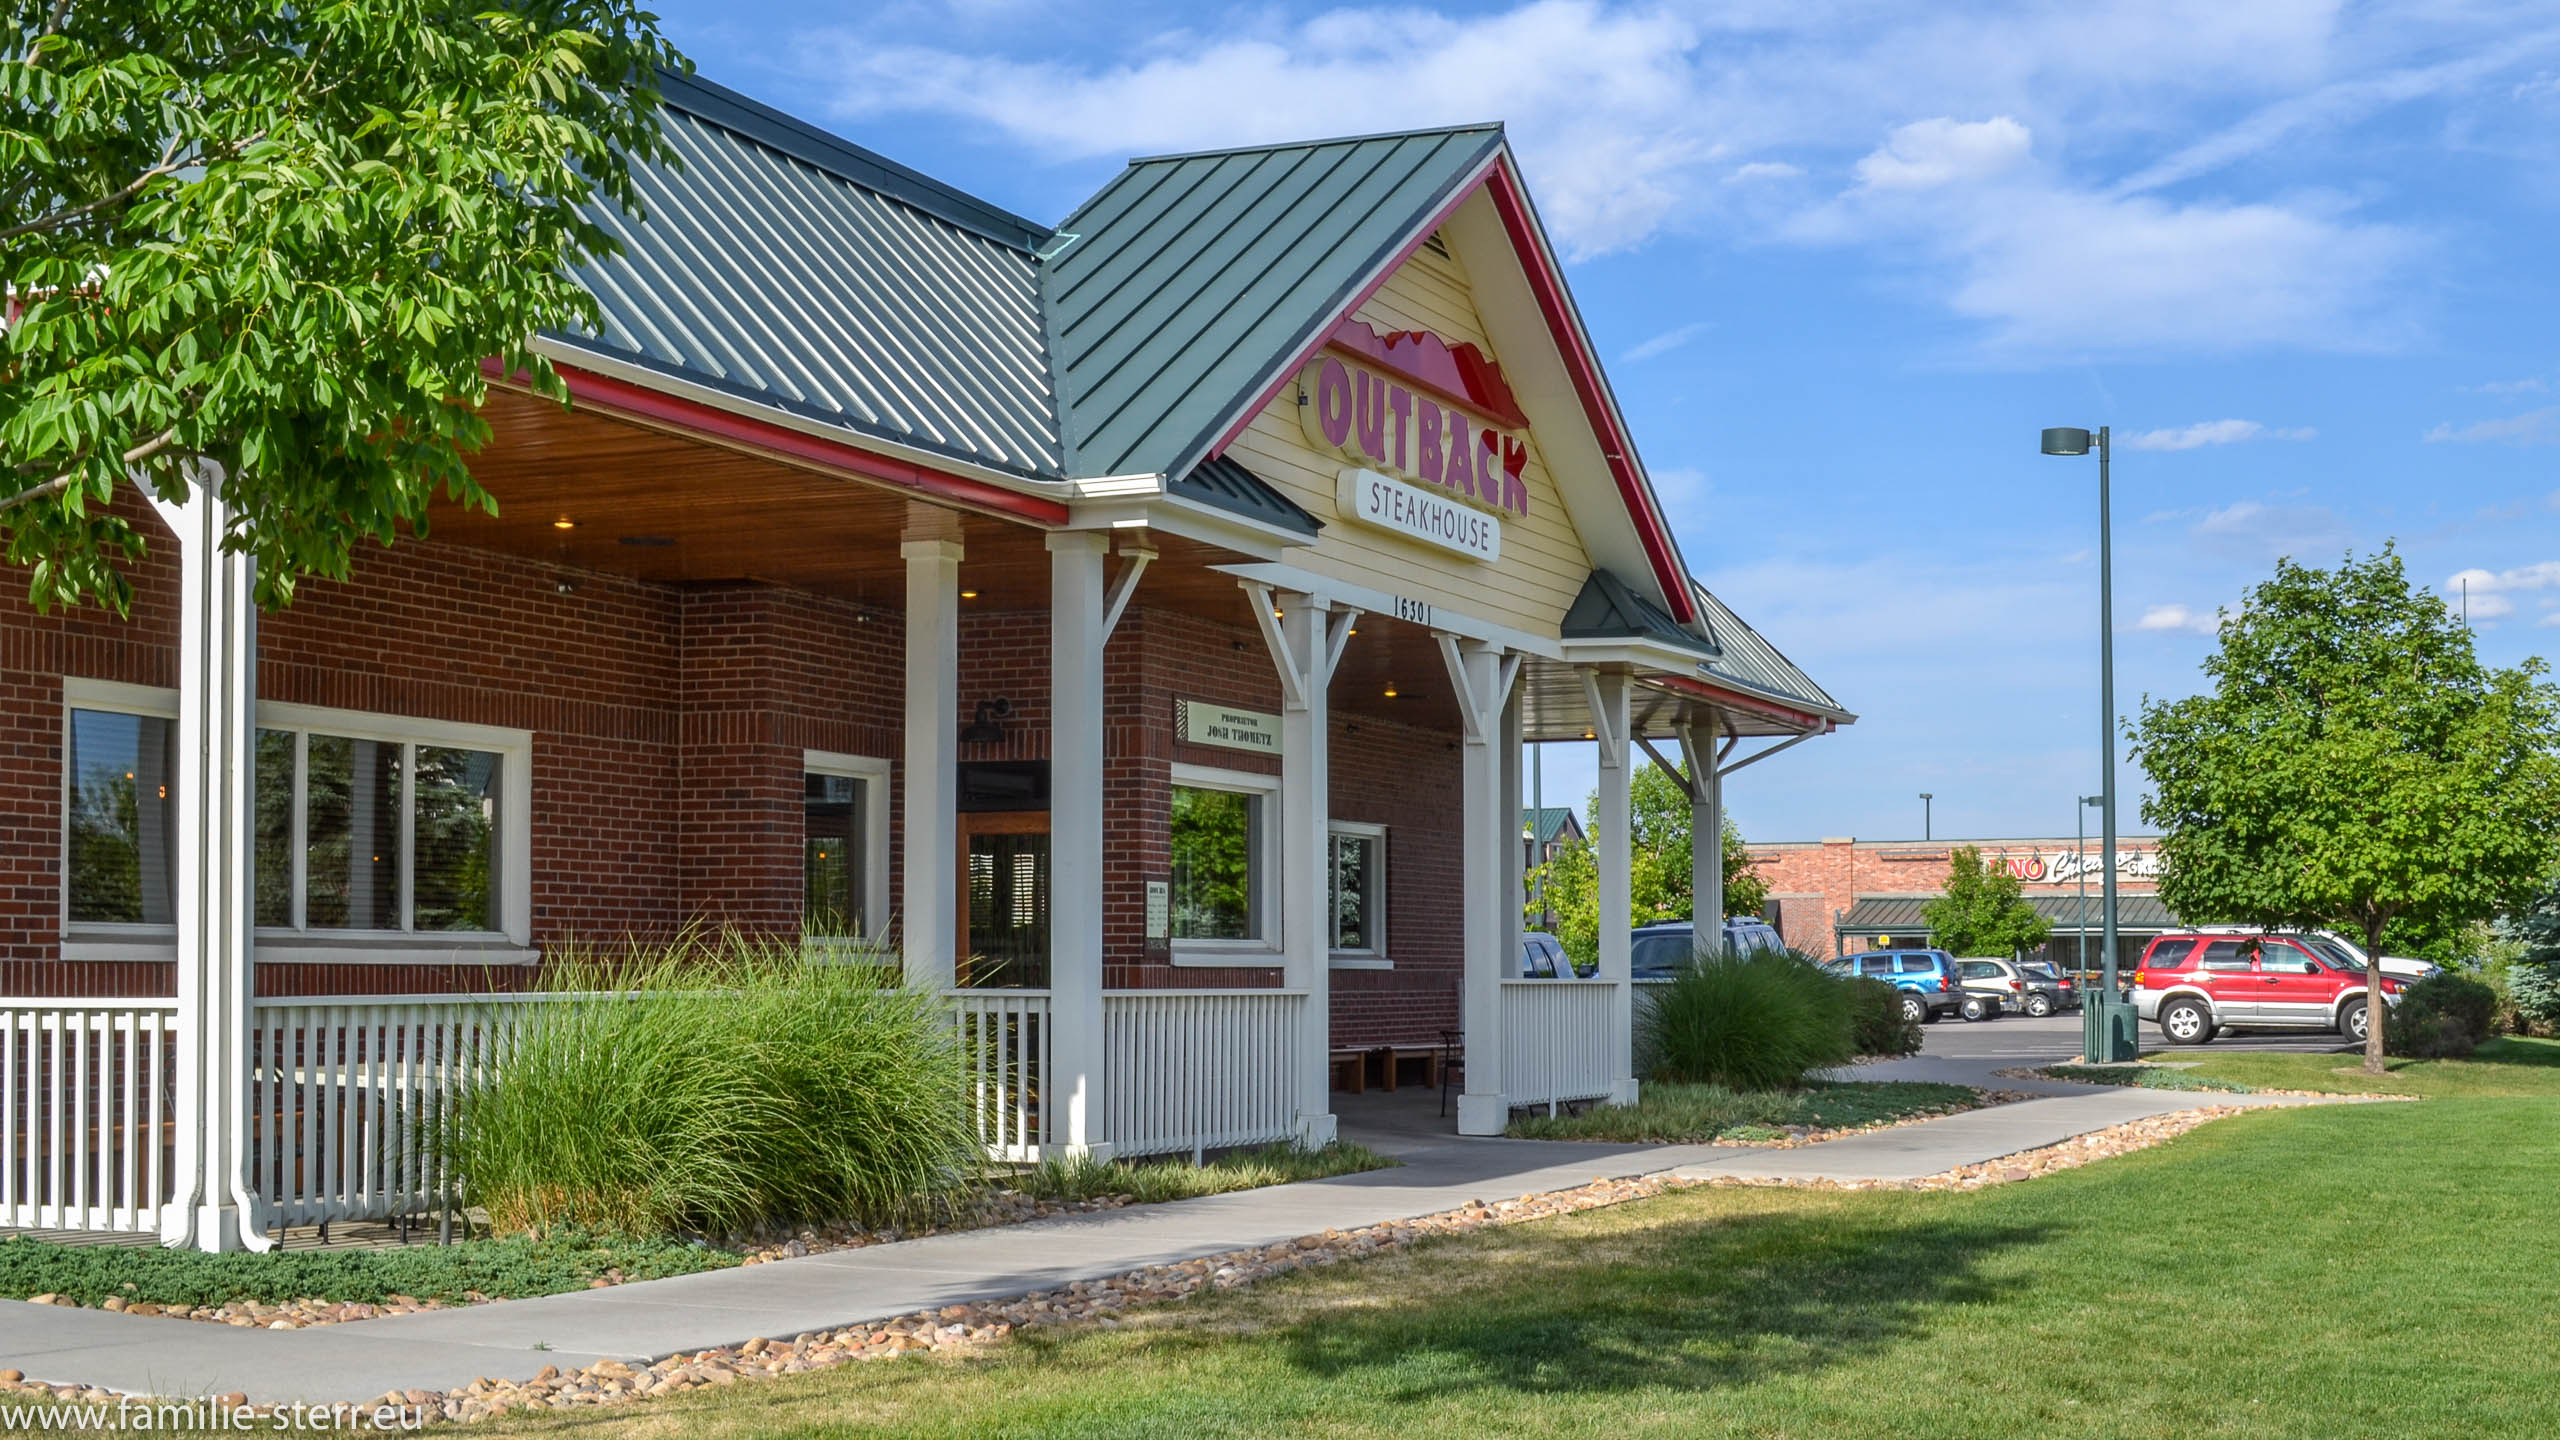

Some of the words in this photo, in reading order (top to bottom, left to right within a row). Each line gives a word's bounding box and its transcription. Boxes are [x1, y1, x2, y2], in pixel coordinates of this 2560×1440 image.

[1318, 357, 1528, 519] OUTBACK
[1370, 481, 1489, 552] STEAKHOUSE
[1394, 595, 1431, 626] 16301
[1207, 724, 1229, 740] JOSH
[1221, 713, 1258, 727] PROPRIETOR
